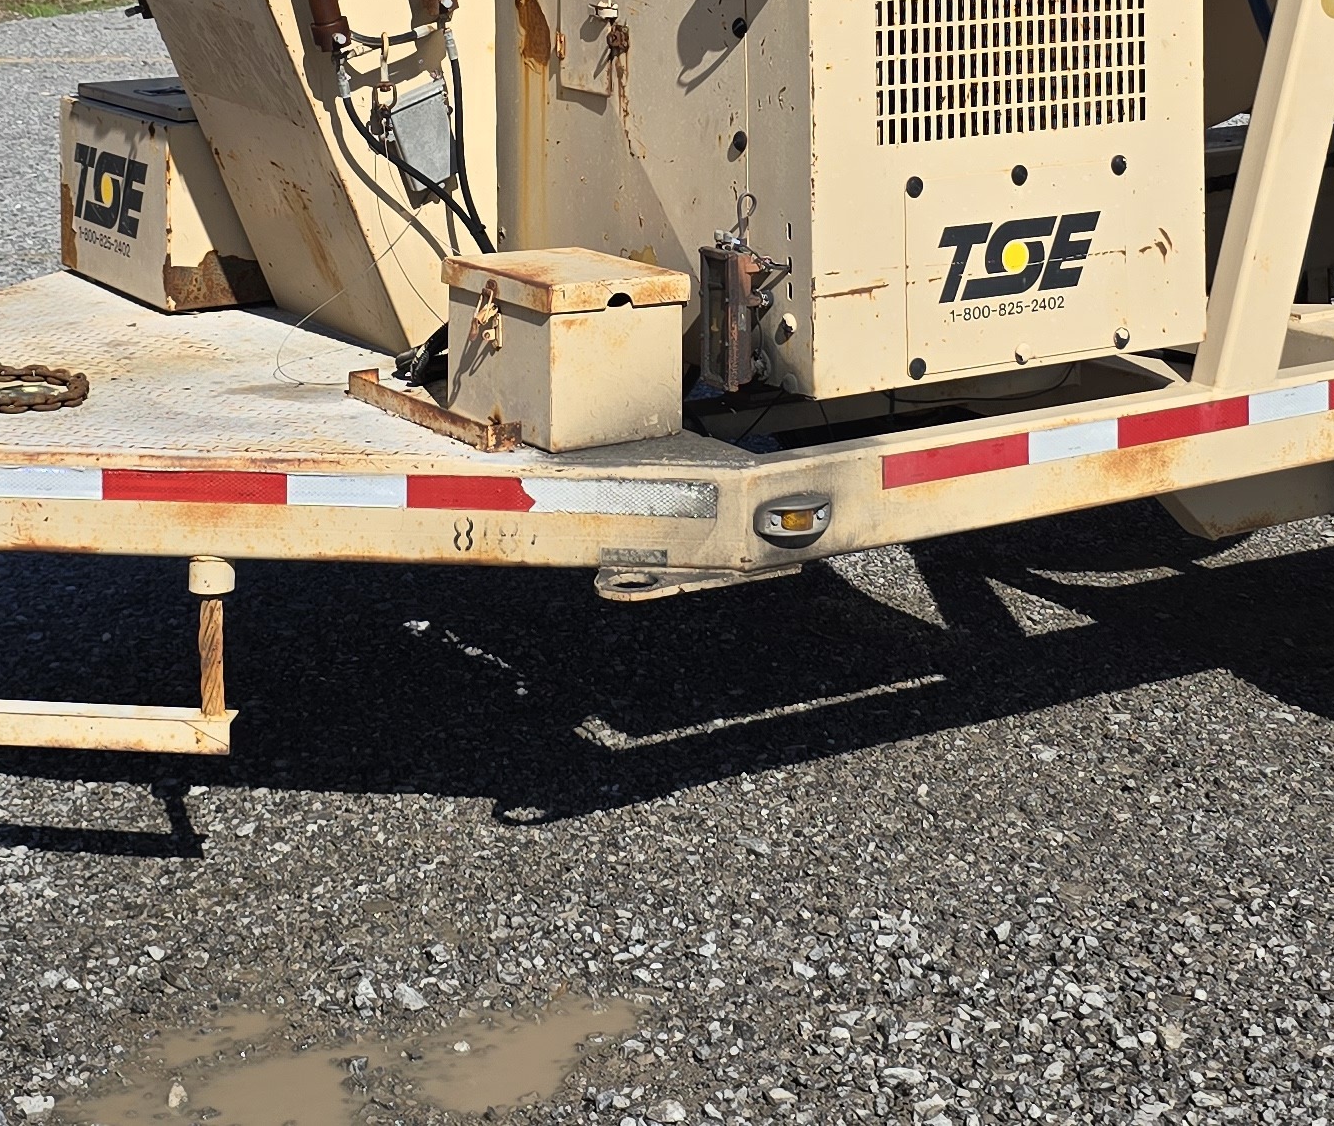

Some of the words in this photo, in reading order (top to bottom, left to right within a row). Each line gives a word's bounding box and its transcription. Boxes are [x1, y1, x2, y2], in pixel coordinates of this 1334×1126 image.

[73, 142, 148, 239] TSE
[78, 225, 131, 258] 1-800-825-2402
[937, 210, 1102, 304] TSE
[949, 295, 1065, 323] 1-800-825-2402
